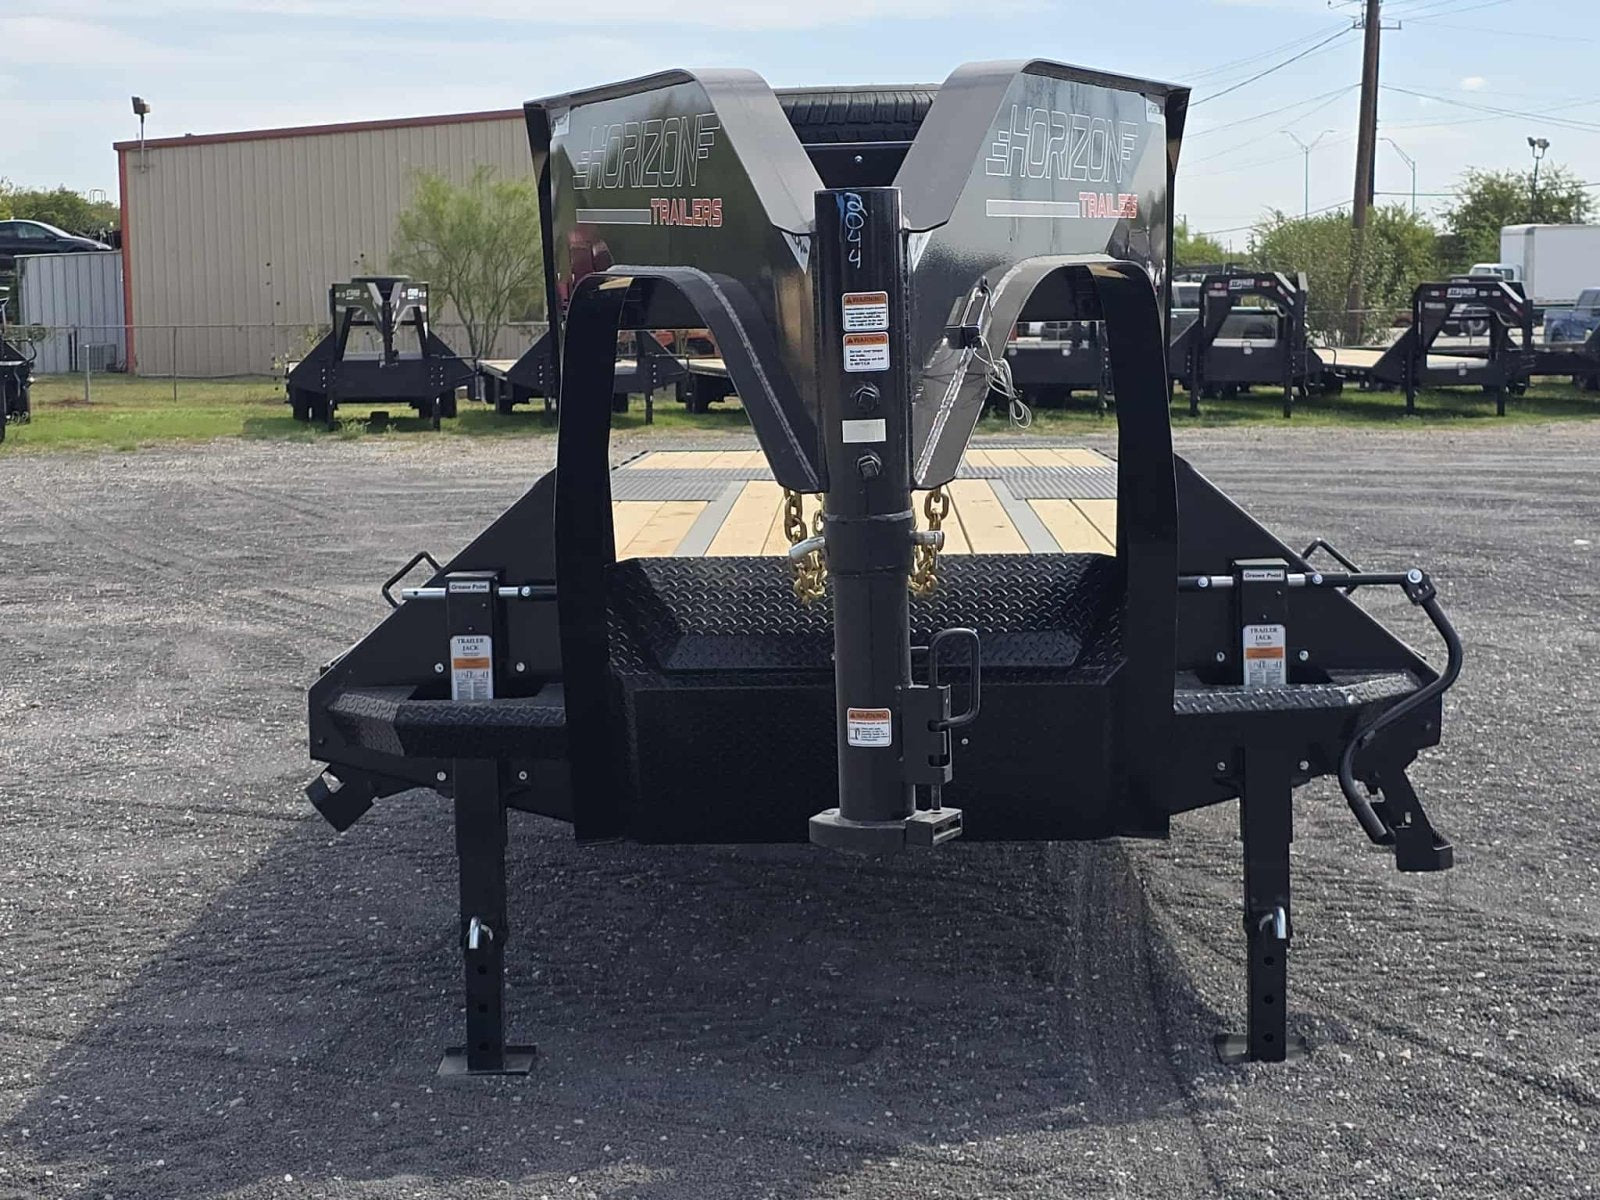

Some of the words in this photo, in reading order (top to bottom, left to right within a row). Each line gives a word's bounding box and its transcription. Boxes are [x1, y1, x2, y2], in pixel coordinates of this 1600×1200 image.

[583, 115, 706, 190] HORIZON
[1001, 104, 1128, 184] HORIZON
[651, 198, 723, 228] TRAILERS
[1079, 191, 1139, 219] TRAILERS
